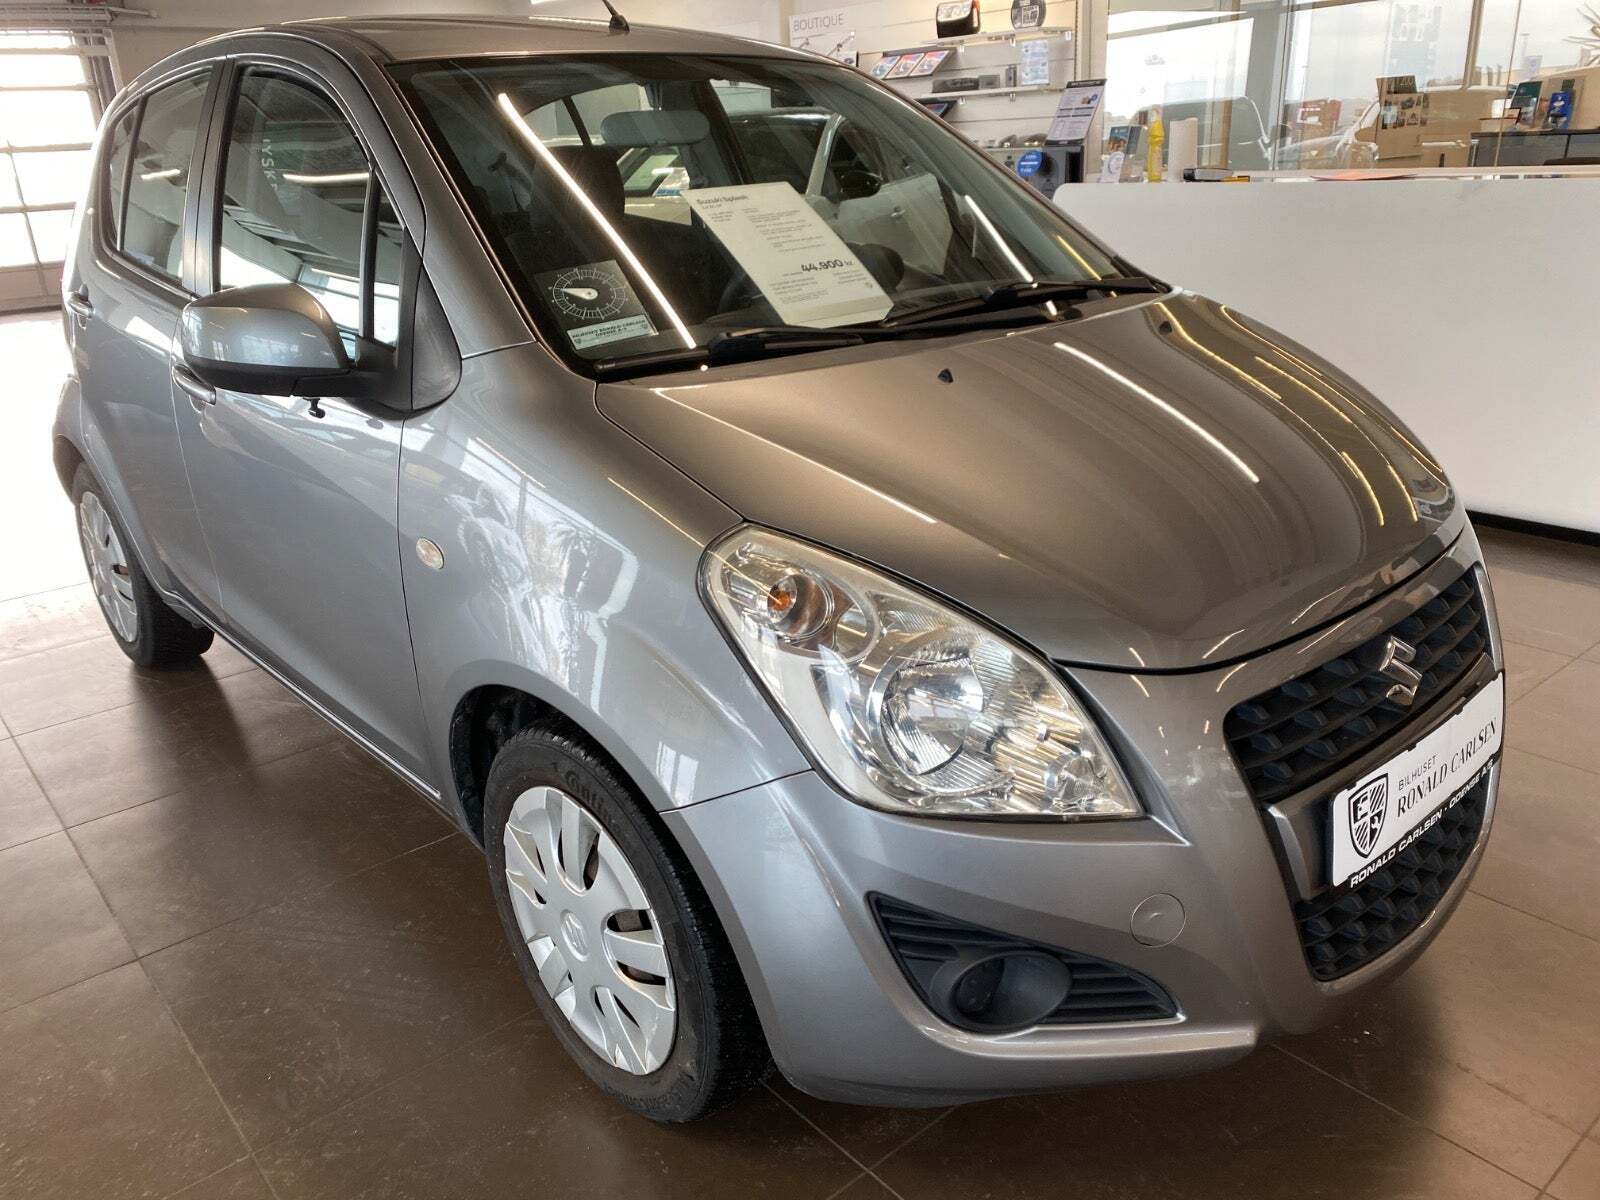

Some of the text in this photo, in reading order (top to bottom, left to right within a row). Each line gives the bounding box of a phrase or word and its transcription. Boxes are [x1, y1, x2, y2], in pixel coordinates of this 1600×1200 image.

[793, 13, 844, 31] BOUTIQUE
[1398, 716, 1497, 818] RONALD CARLSEN
[1398, 754, 1437, 791] BILHUSET
[1350, 847, 1397, 888] RONALD
[1398, 808, 1443, 852] CARLSEN
[1449, 772, 1481, 809] ODENSE
